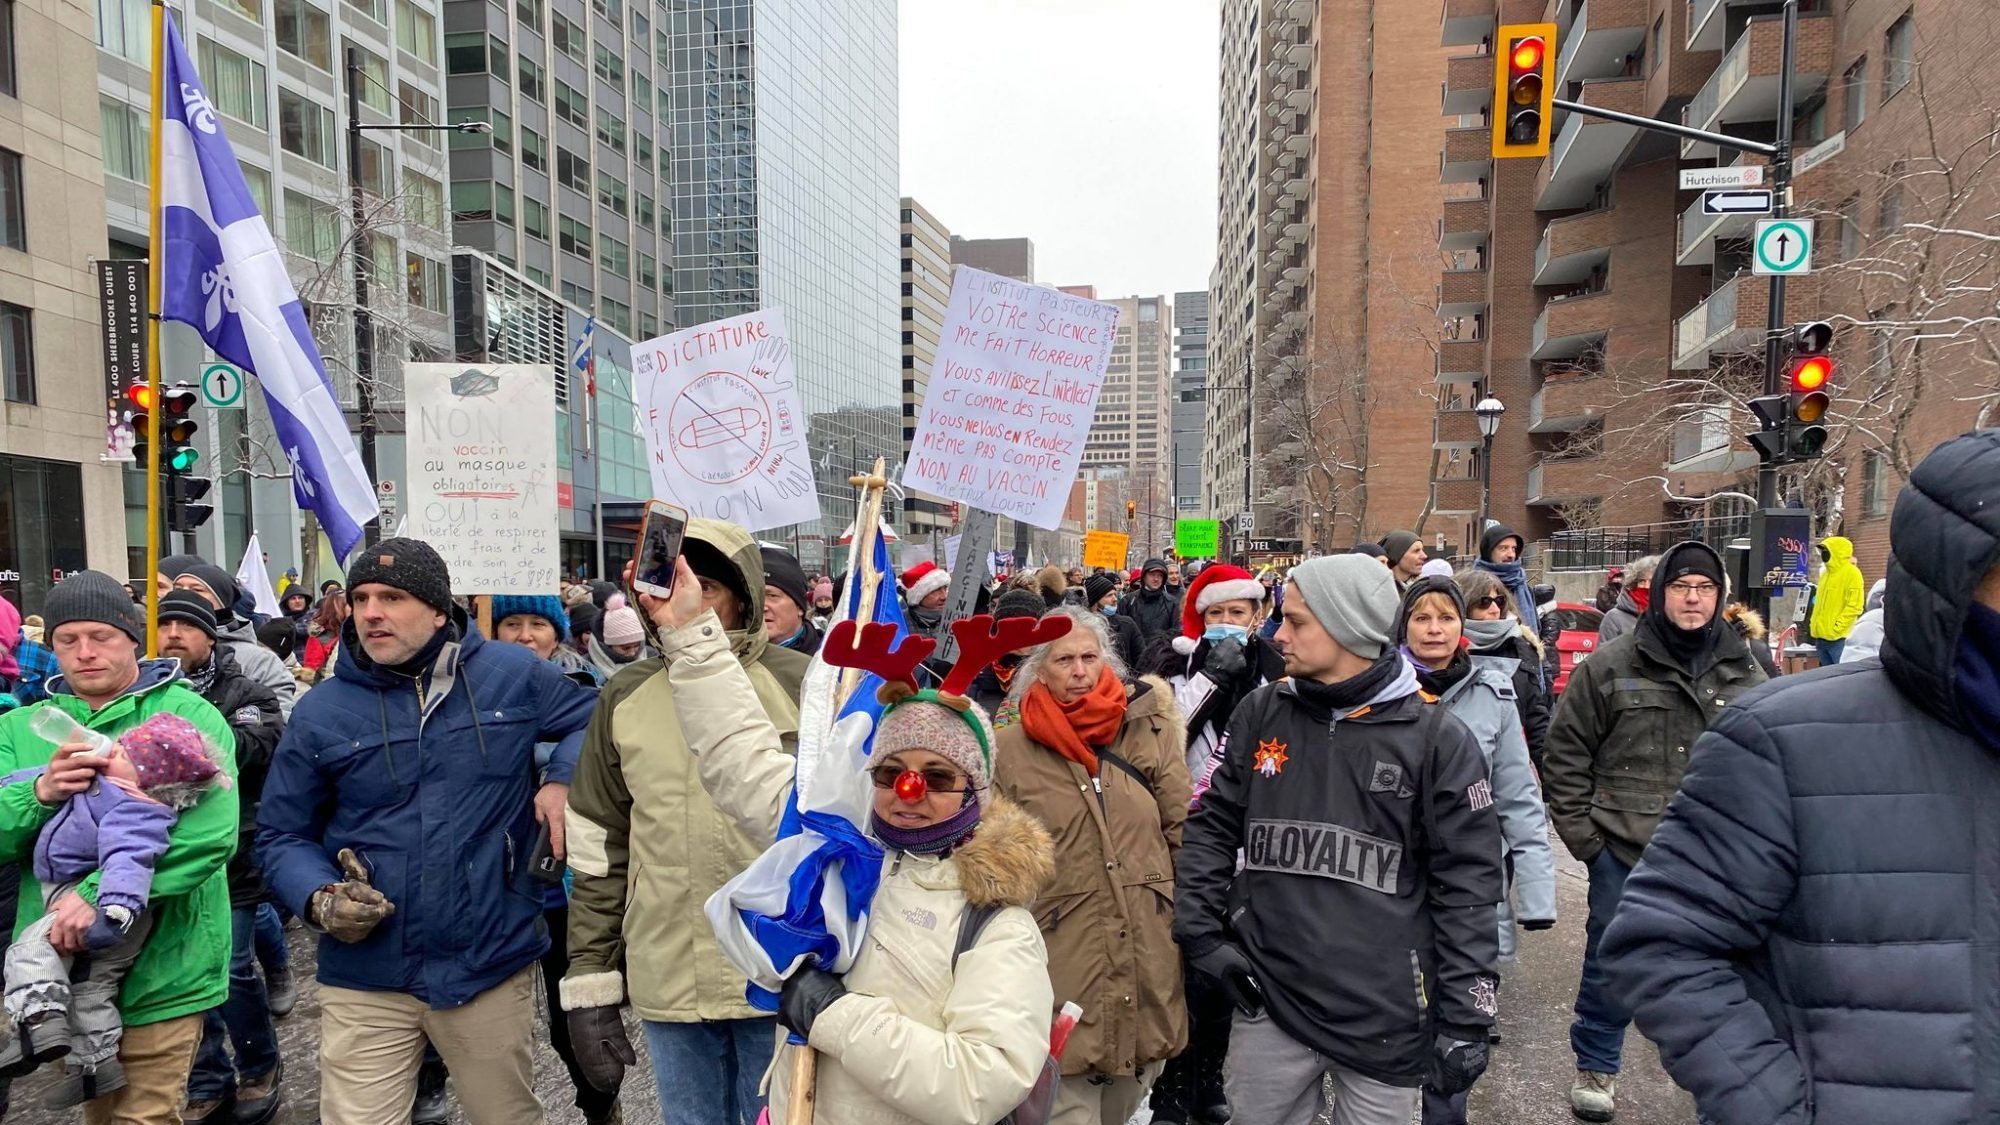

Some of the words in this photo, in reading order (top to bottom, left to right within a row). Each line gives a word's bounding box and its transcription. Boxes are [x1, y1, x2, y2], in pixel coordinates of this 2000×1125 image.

[1686, 175, 1740, 186] Hutchison
[105, 266, 114, 296] OUEST
[127, 265, 136, 291] 0011
[129, 294, 137, 313] 840
[107, 299, 118, 361] SHERBROOKE
[132, 342, 140, 372] LOUER
[636, 352, 651, 365] NON
[111, 365, 119, 386] 400
[638, 363, 653, 374] NON
[112, 389, 120, 399] LE
[421, 406, 503, 443] NON
[454, 440, 509, 456] vaccin
[424, 460, 444, 472] au
[458, 460, 528, 476] masque
[958, 464, 978, 486] AU
[432, 476, 516, 494] obligatoires
[690, 486, 763, 519] NON
[508, 508, 519, 520] la
[1241, 517, 1253, 528] 50
[386, 518, 392, 528] P
[422, 524, 462, 537] liberté
[468, 527, 484, 537] de
[496, 528, 546, 543] respirer
[471, 540, 502, 557] frais
[512, 545, 521, 553] et
[530, 542, 547, 554] de
[483, 559, 507, 568] soin
[518, 558, 535, 568] de
[450, 577, 462, 585] a
[473, 571, 518, 587] santé
[1250, 824, 1397, 888] GLOYALTY
